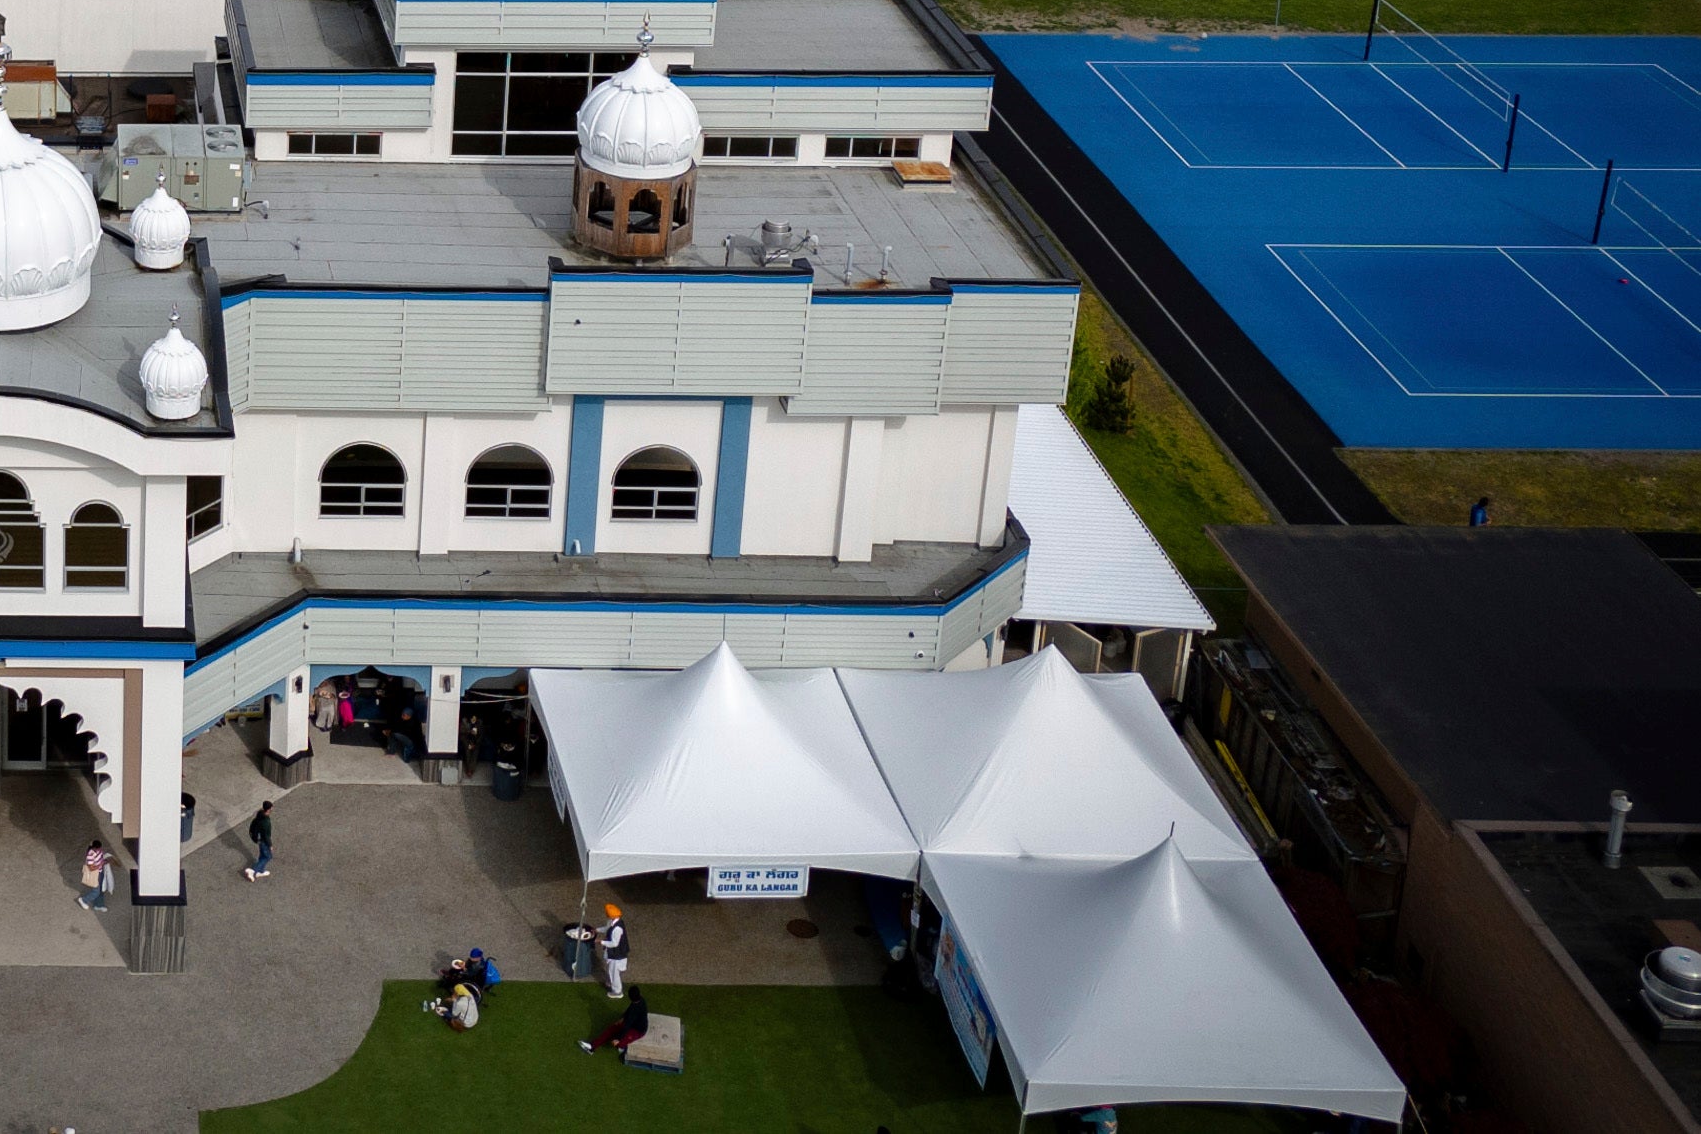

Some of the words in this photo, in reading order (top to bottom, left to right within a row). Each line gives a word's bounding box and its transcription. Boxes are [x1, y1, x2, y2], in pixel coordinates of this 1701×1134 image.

[746, 870, 760, 879] ਕਾ
[718, 884, 742, 892] GURU
[745, 884, 758, 892] KA
[761, 883, 798, 892] LANGAR
